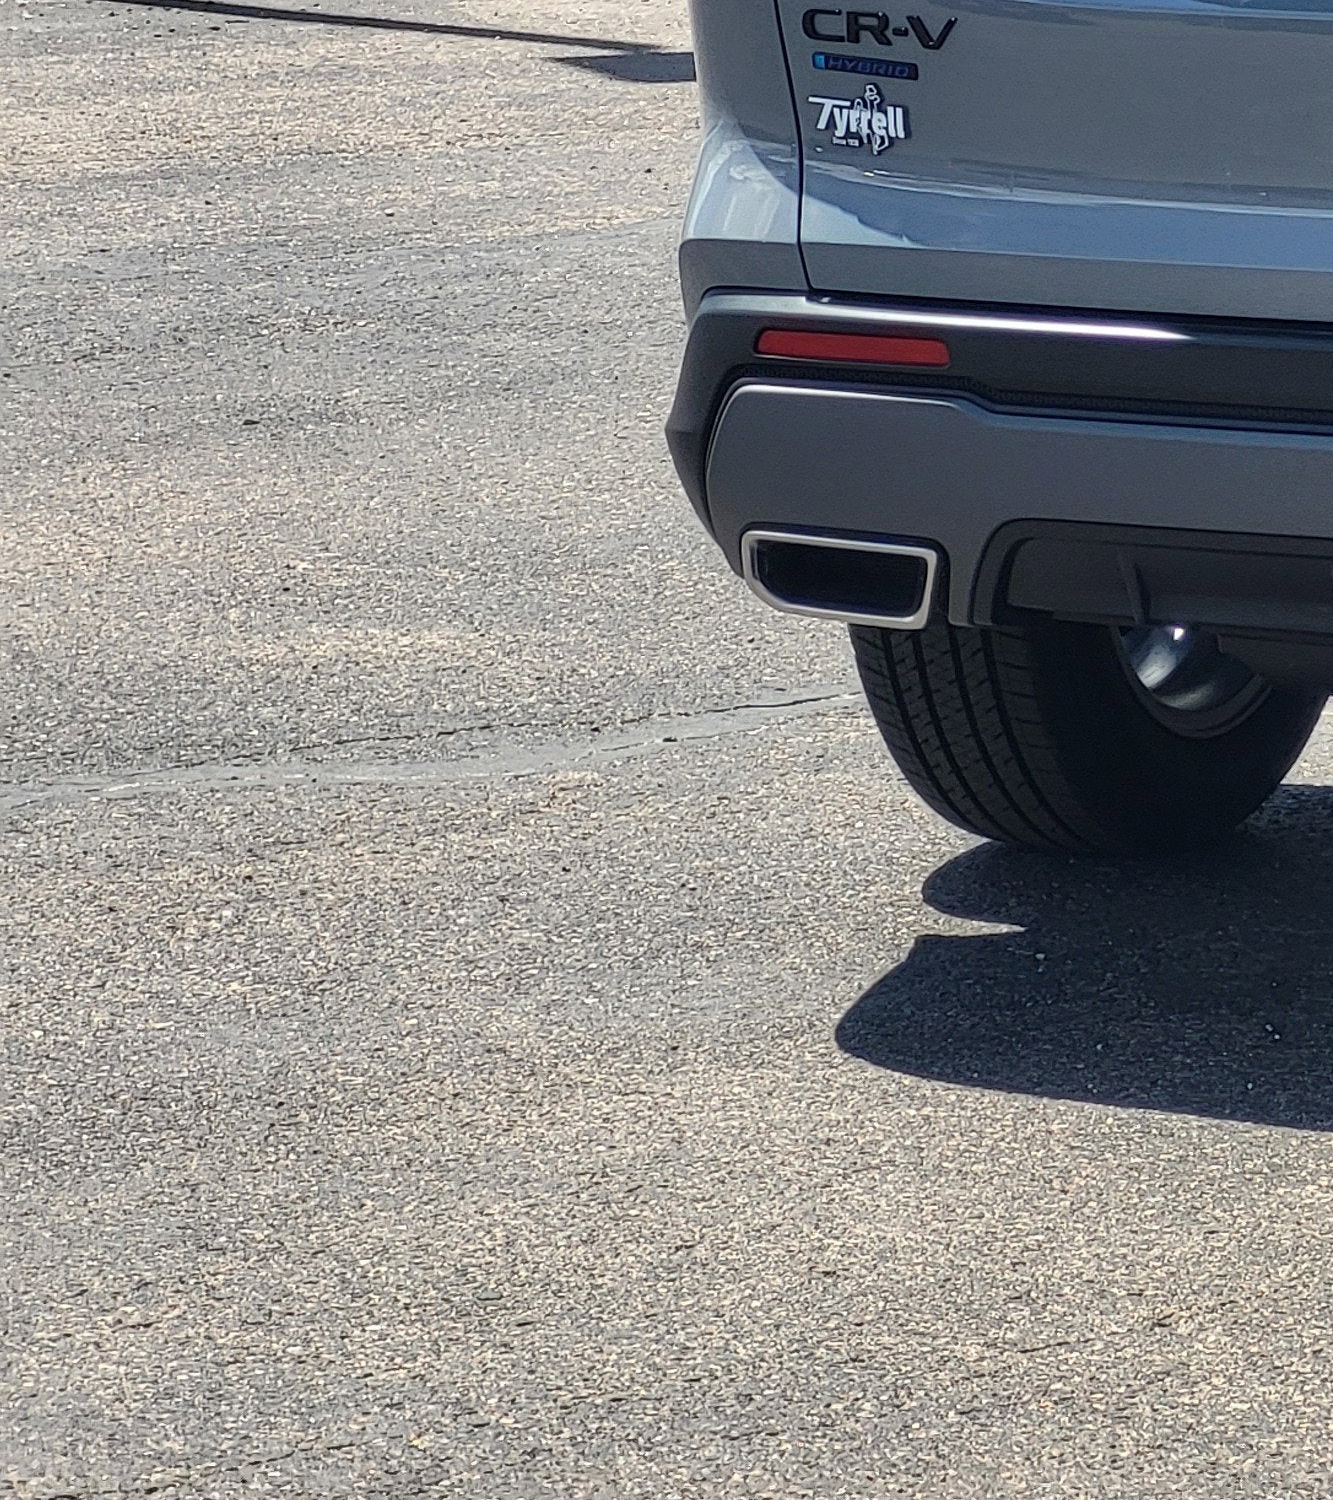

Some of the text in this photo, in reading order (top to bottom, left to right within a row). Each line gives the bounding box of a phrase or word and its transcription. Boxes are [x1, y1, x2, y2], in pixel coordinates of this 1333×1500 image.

[802, 8, 958, 50] CR-V
[829, 56, 909, 77] HYBRID
[807, 96, 906, 139] Tyrrell
